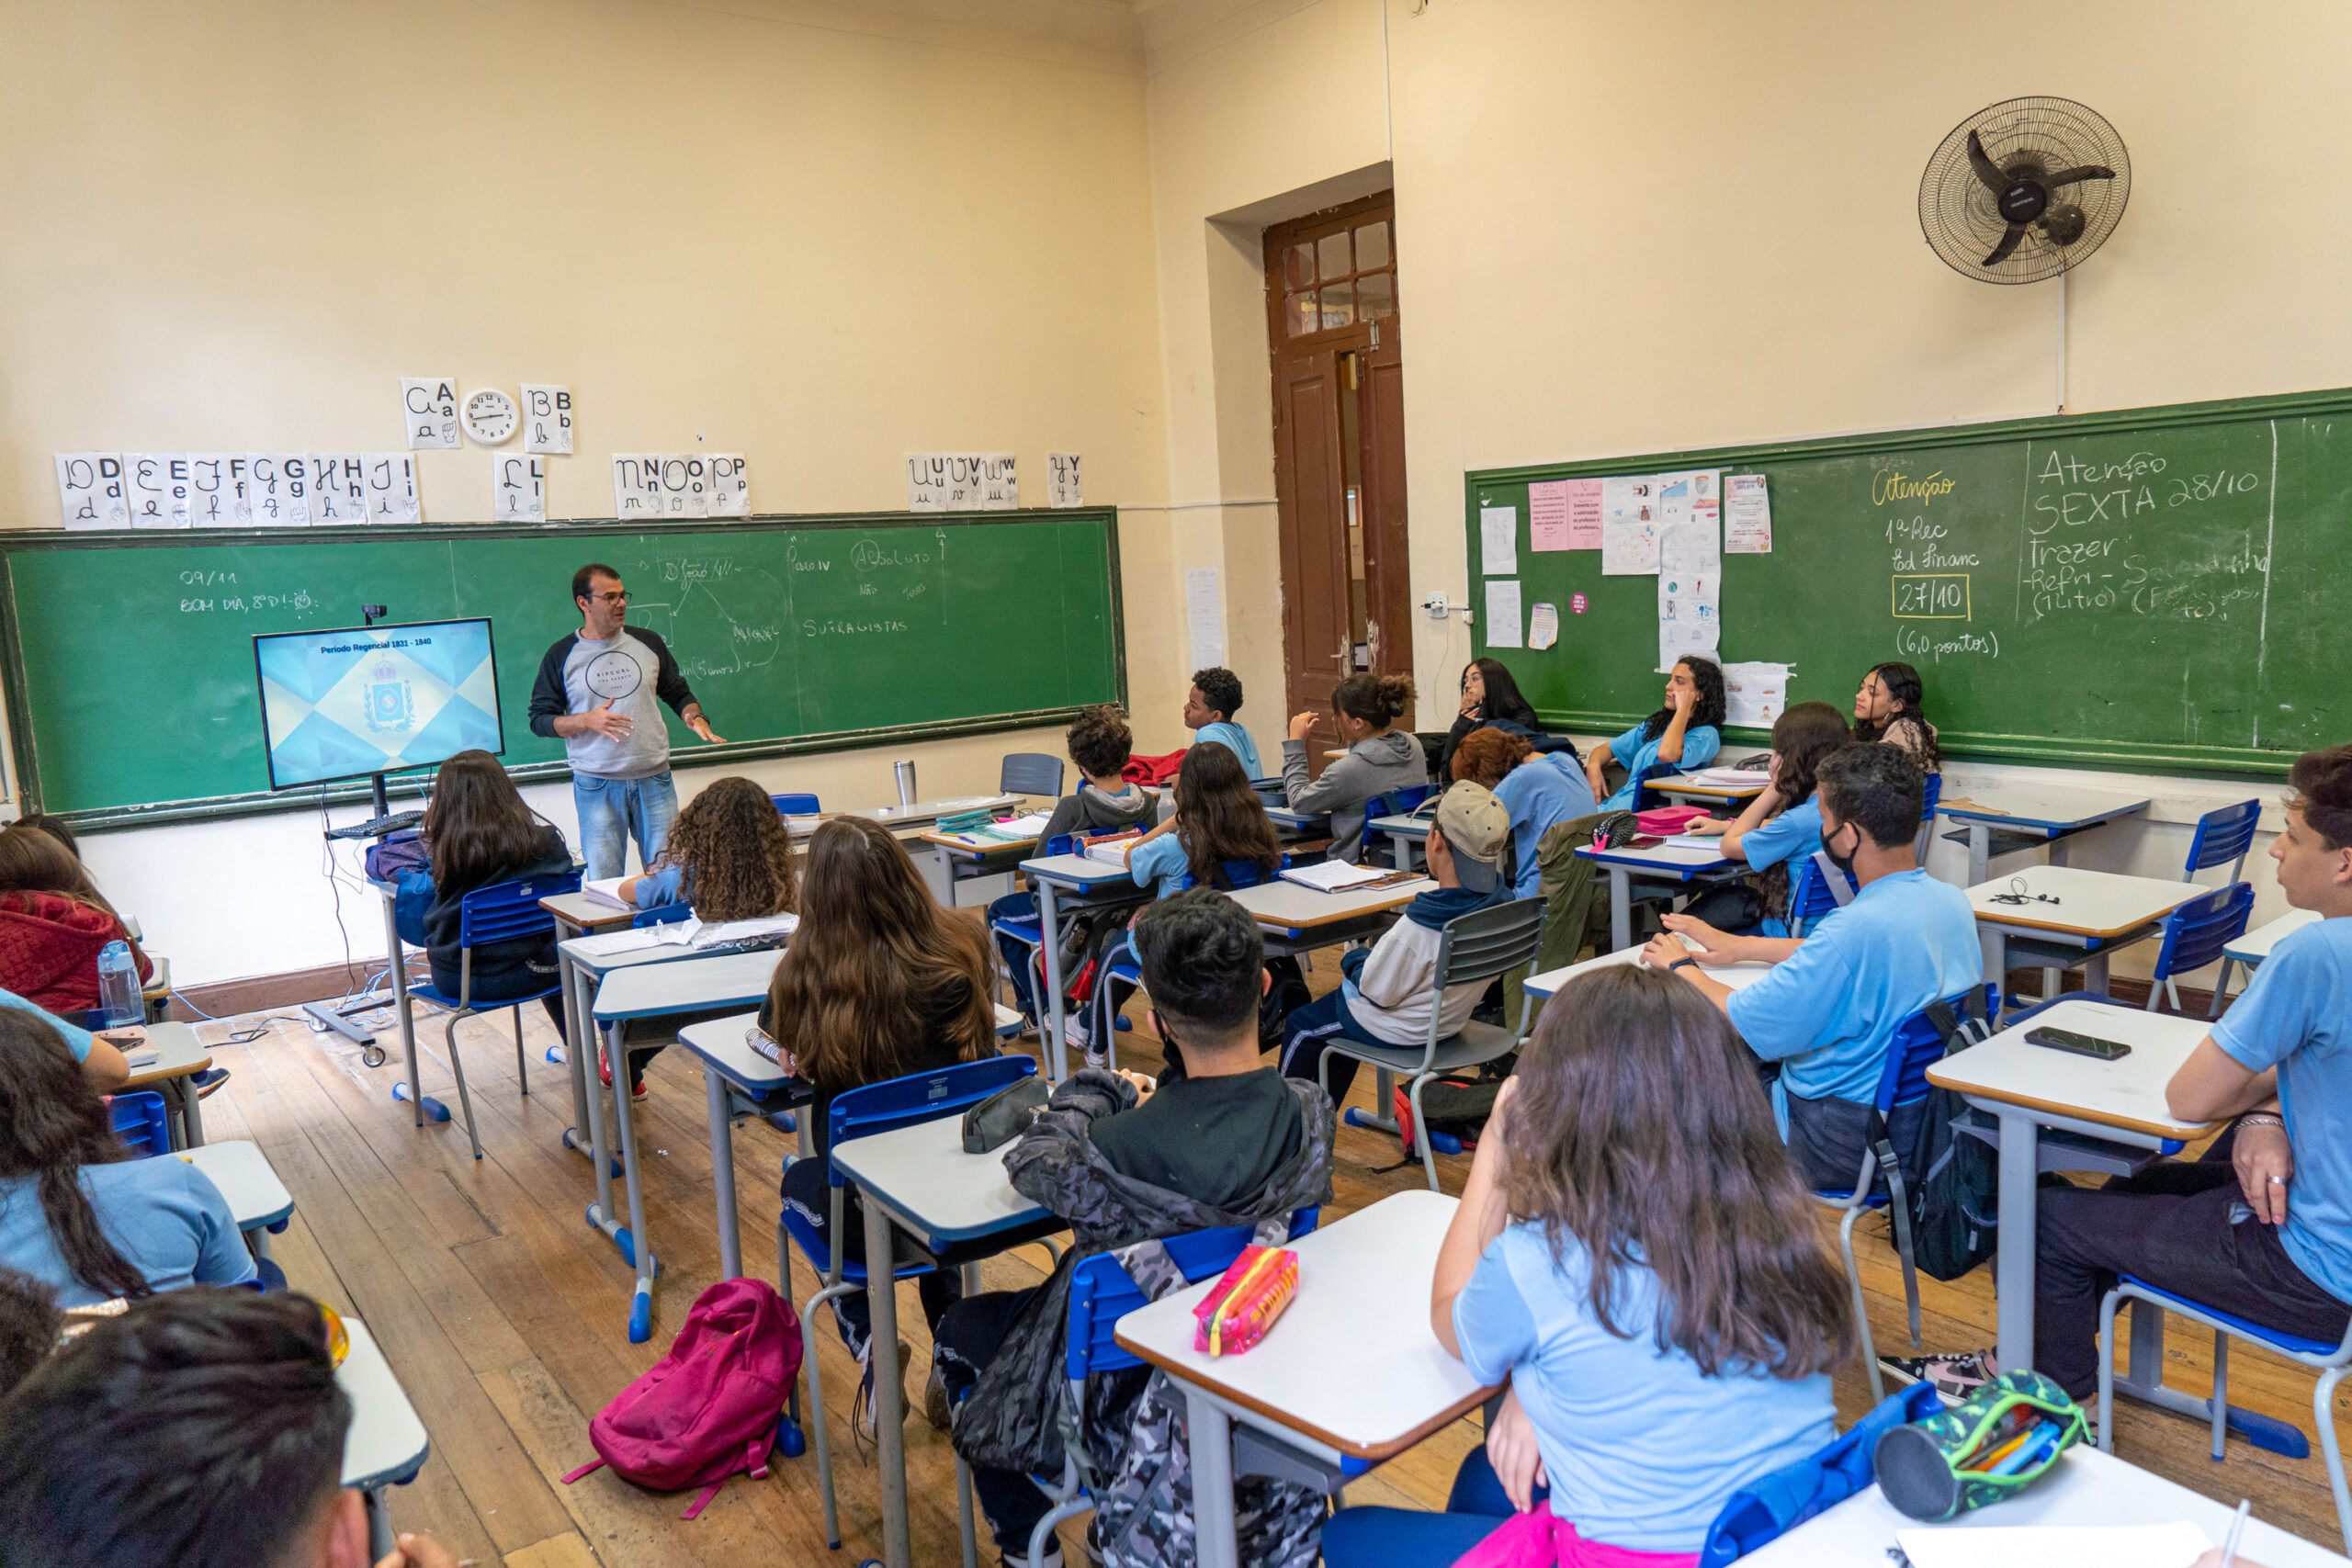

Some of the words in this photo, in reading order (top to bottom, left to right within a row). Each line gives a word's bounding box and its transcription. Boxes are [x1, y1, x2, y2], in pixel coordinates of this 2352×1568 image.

[436, 382, 454, 401] A
[556, 391, 571, 411] B
[442, 405, 454, 417] a
[560, 413, 571, 428] b
[99, 458, 120, 478] D
[170, 460, 188, 479] E
[231, 459, 245, 479] F
[284, 459, 305, 478] G
[345, 458, 362, 478] H
[531, 459, 544, 478] L
[644, 459, 659, 476] N
[687, 460, 703, 477] O
[733, 458, 745, 475] P
[932, 458, 944, 473] U
[969, 458, 980, 473] V
[1003, 458, 1014, 470] W
[1069, 457, 1080, 471] Y
[2037, 450, 2167, 485] Atenção
[349, 481, 361, 497] h
[648, 480, 658, 492] n
[692, 482, 703, 493] o
[738, 480, 746, 491] p
[935, 478, 944, 488] u
[971, 476, 979, 487] v
[1007, 477, 1016, 485] w
[1073, 475, 1080, 486] y
[107, 481, 121, 498] d
[173, 486, 187, 499] e
[234, 481, 245, 498] f
[290, 481, 304, 498] g
[2028, 485, 2156, 535] SEXTA
[2168, 469, 2258, 507] 28/10
[1911, 515, 1948, 540] Rec
[1892, 548, 1917, 571] Ed
[1923, 543, 1980, 569] Financ
[179, 570, 237, 586] 09/11
[180, 598, 213, 613] BOM
[1899, 580, 1961, 615] 27/10
[353, 641, 390, 652] Regencial
[391, 639, 408, 649] 1831
[414, 637, 432, 646] 1840
[1896, 626, 1929, 656] (6,0
[1933, 630, 1998, 664] pontos)
